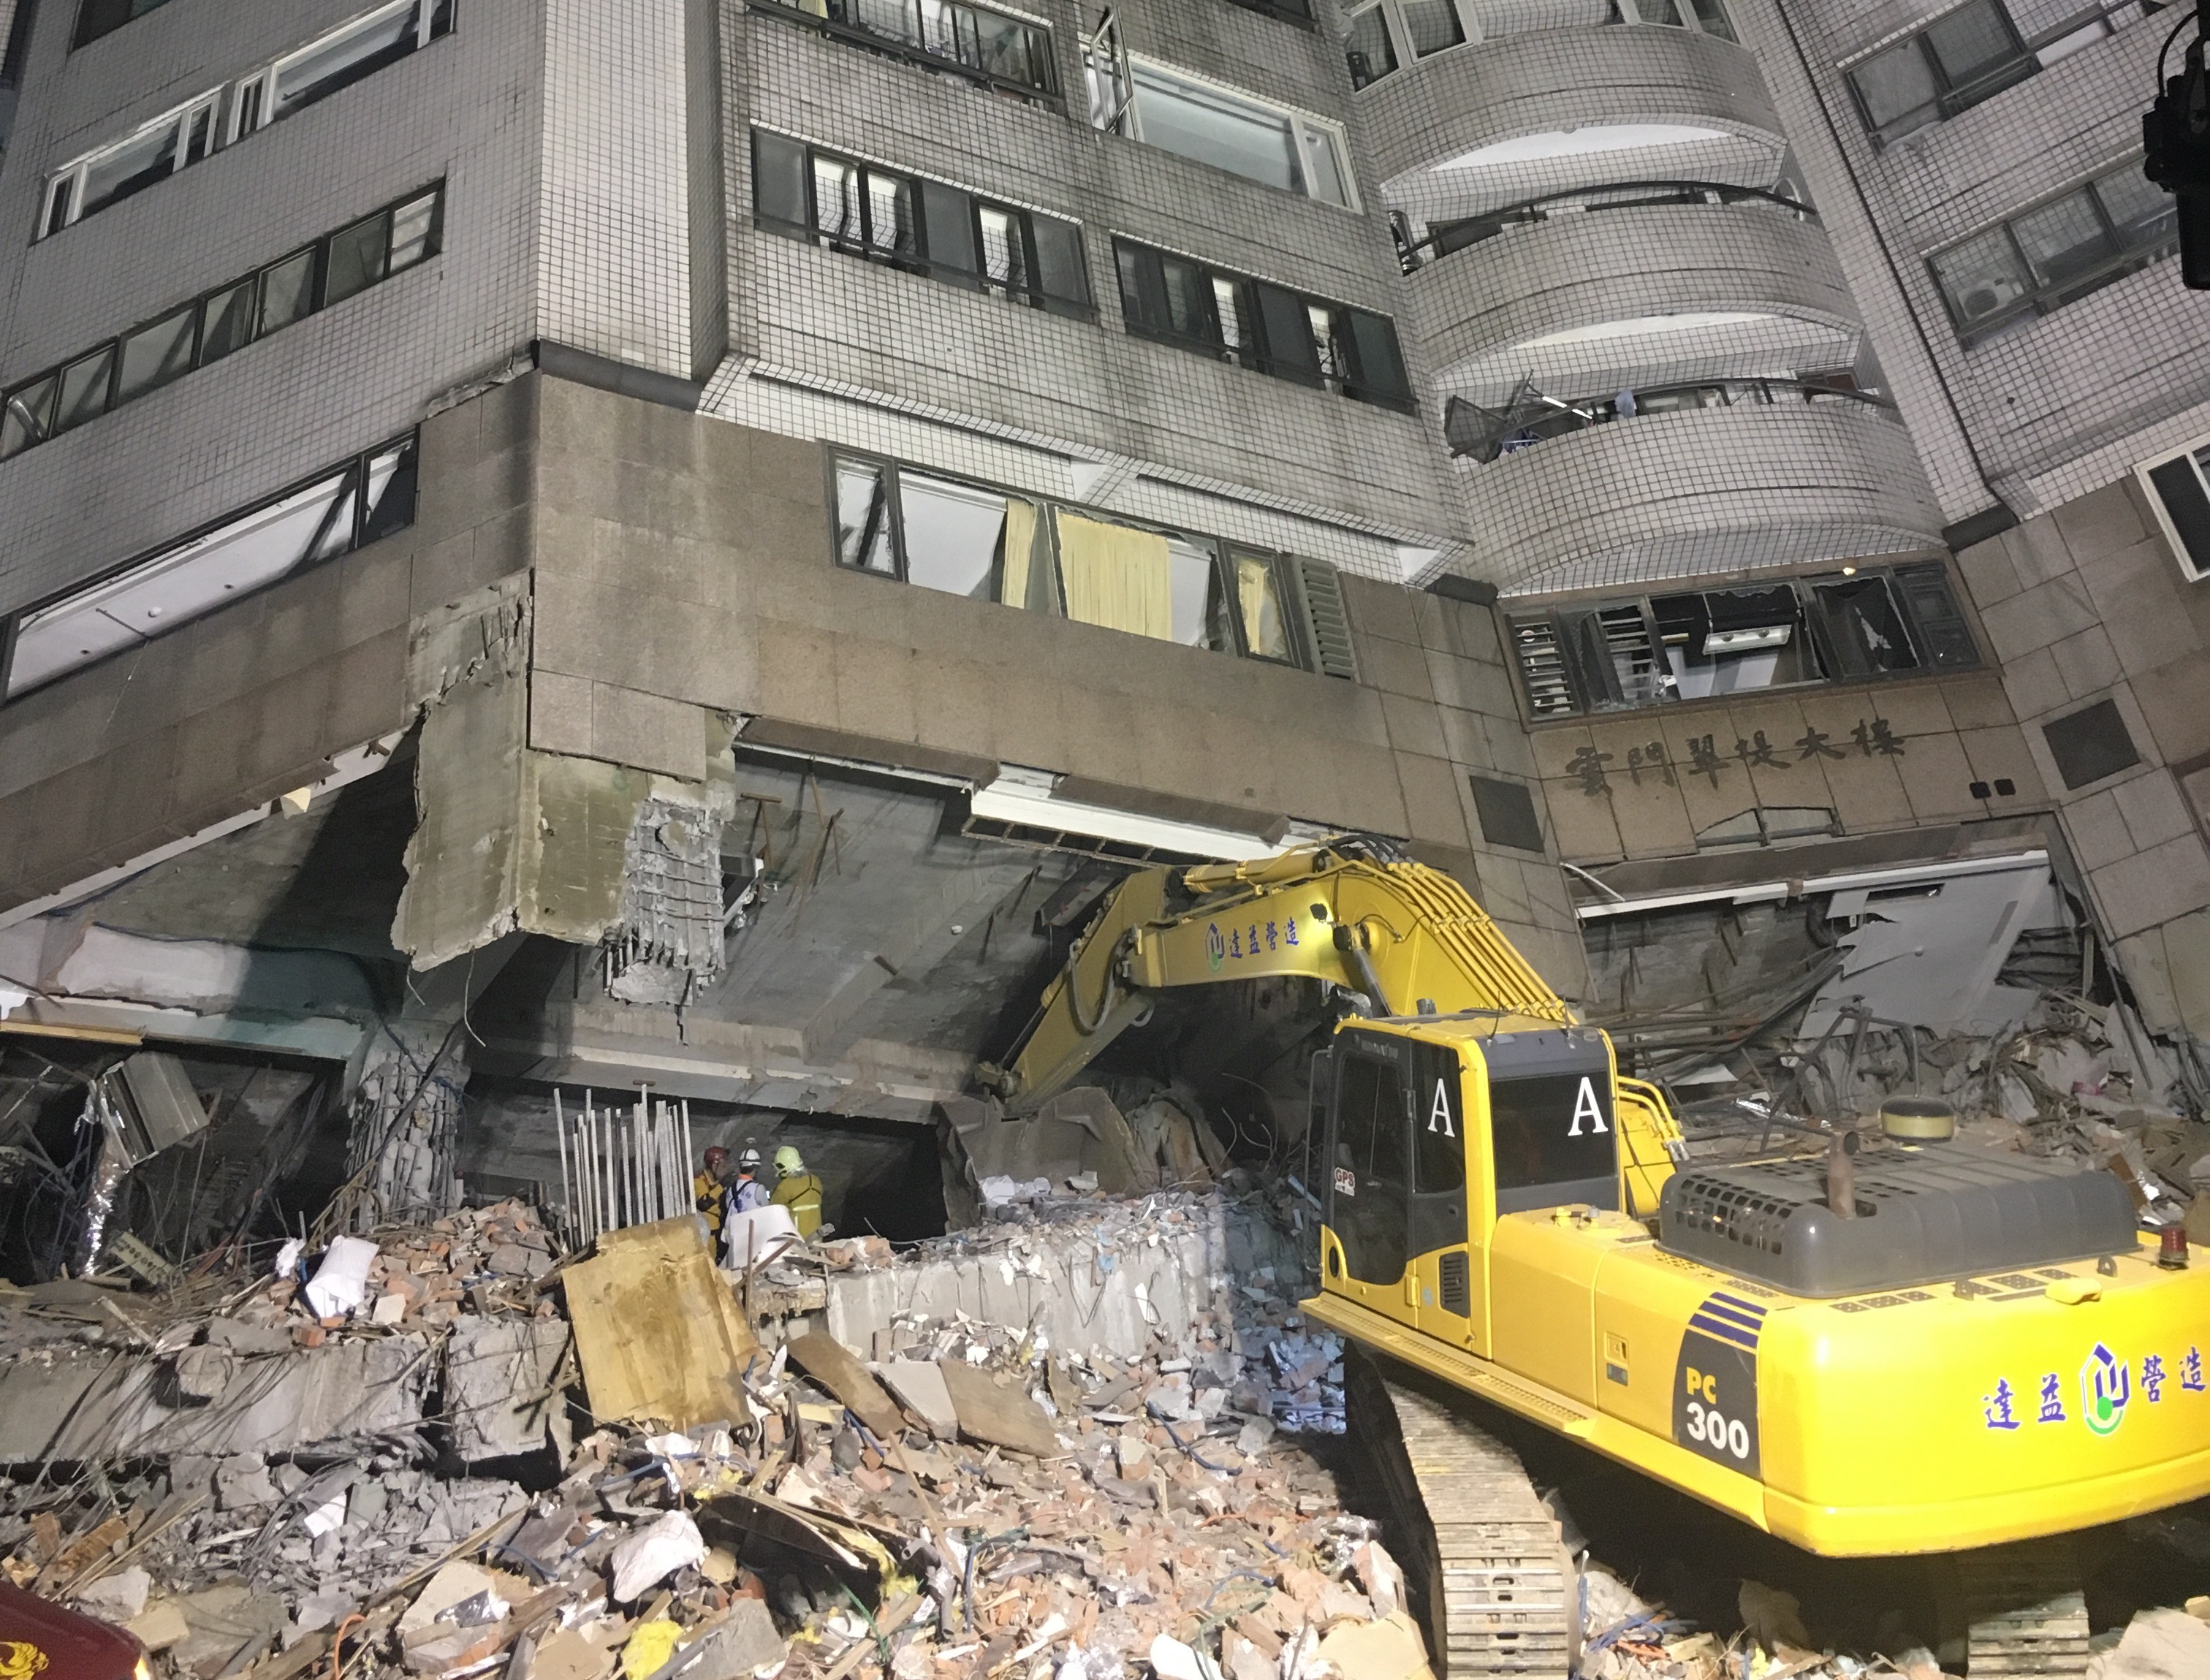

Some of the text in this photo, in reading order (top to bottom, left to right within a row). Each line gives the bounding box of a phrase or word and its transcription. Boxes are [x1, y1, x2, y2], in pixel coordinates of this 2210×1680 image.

[1229, 916, 1299, 959] 達益營造
[1427, 1078, 1455, 1137] A
[1568, 1076, 1609, 1136] A
[1335, 1168, 1354, 1187] GPS
[1686, 1367, 1717, 1405] PC
[1687, 1402, 1750, 1459] 300
